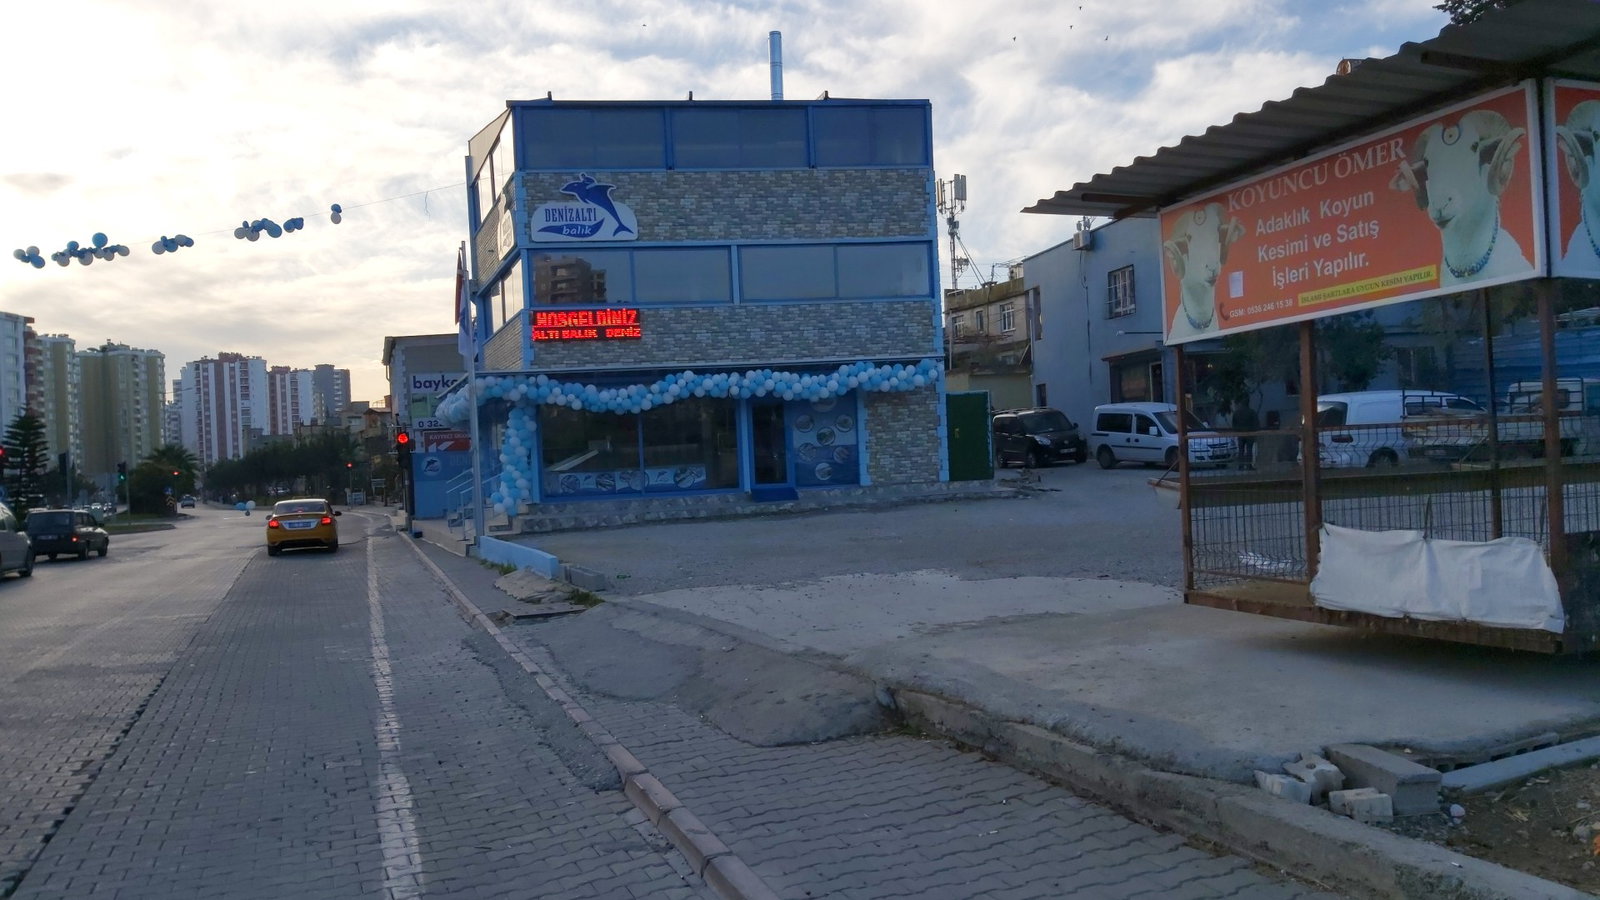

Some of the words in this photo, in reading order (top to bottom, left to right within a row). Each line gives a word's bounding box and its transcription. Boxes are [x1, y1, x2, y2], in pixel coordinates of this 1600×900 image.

[1228, 164, 1329, 212] KOYUNCU
[1335, 138, 1406, 179] ÖMER
[544, 205, 597, 222] DENİZALTI
[1256, 208, 1310, 236] Adaklık
[1320, 190, 1375, 220] Koyun
[562, 225, 592, 235] balık
[1258, 237, 1309, 263] Kesimi
[1313, 231, 1332, 250] ve
[1337, 218, 1380, 240] Satış
[1272, 265, 1309, 290] İşleri
[1313, 251, 1369, 282] Yapılır.
[1356, 283, 1380, 295] UYGUN
[1276, 300, 1284, 309] 15
